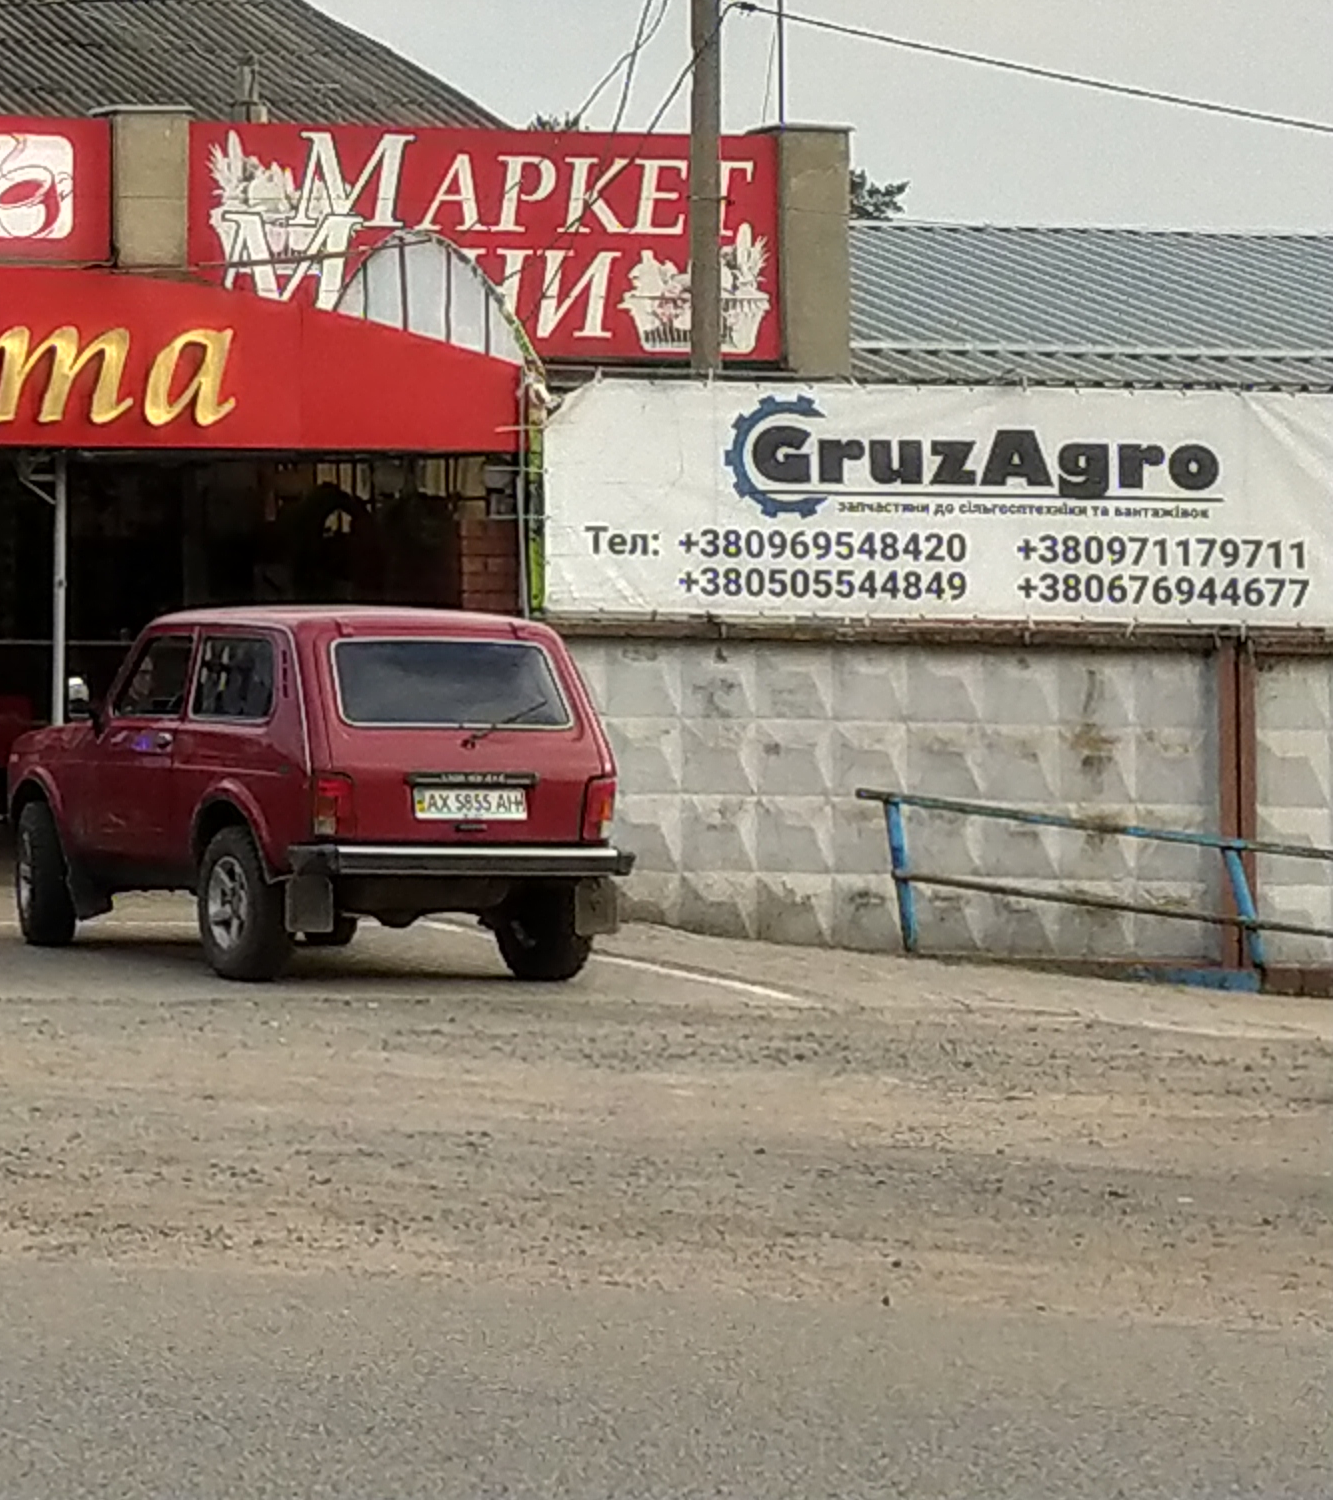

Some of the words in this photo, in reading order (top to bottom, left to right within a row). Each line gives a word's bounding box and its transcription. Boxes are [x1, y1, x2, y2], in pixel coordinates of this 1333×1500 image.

[751, 425, 1220, 499] GruzAgro
[584, 525, 661, 555] Тел:
[679, 529, 967, 562] +380969548420
[1017, 534, 1306, 569] +380971179711
[679, 567, 967, 600] +380505544849
[1017, 573, 1310, 608] +380676944677
